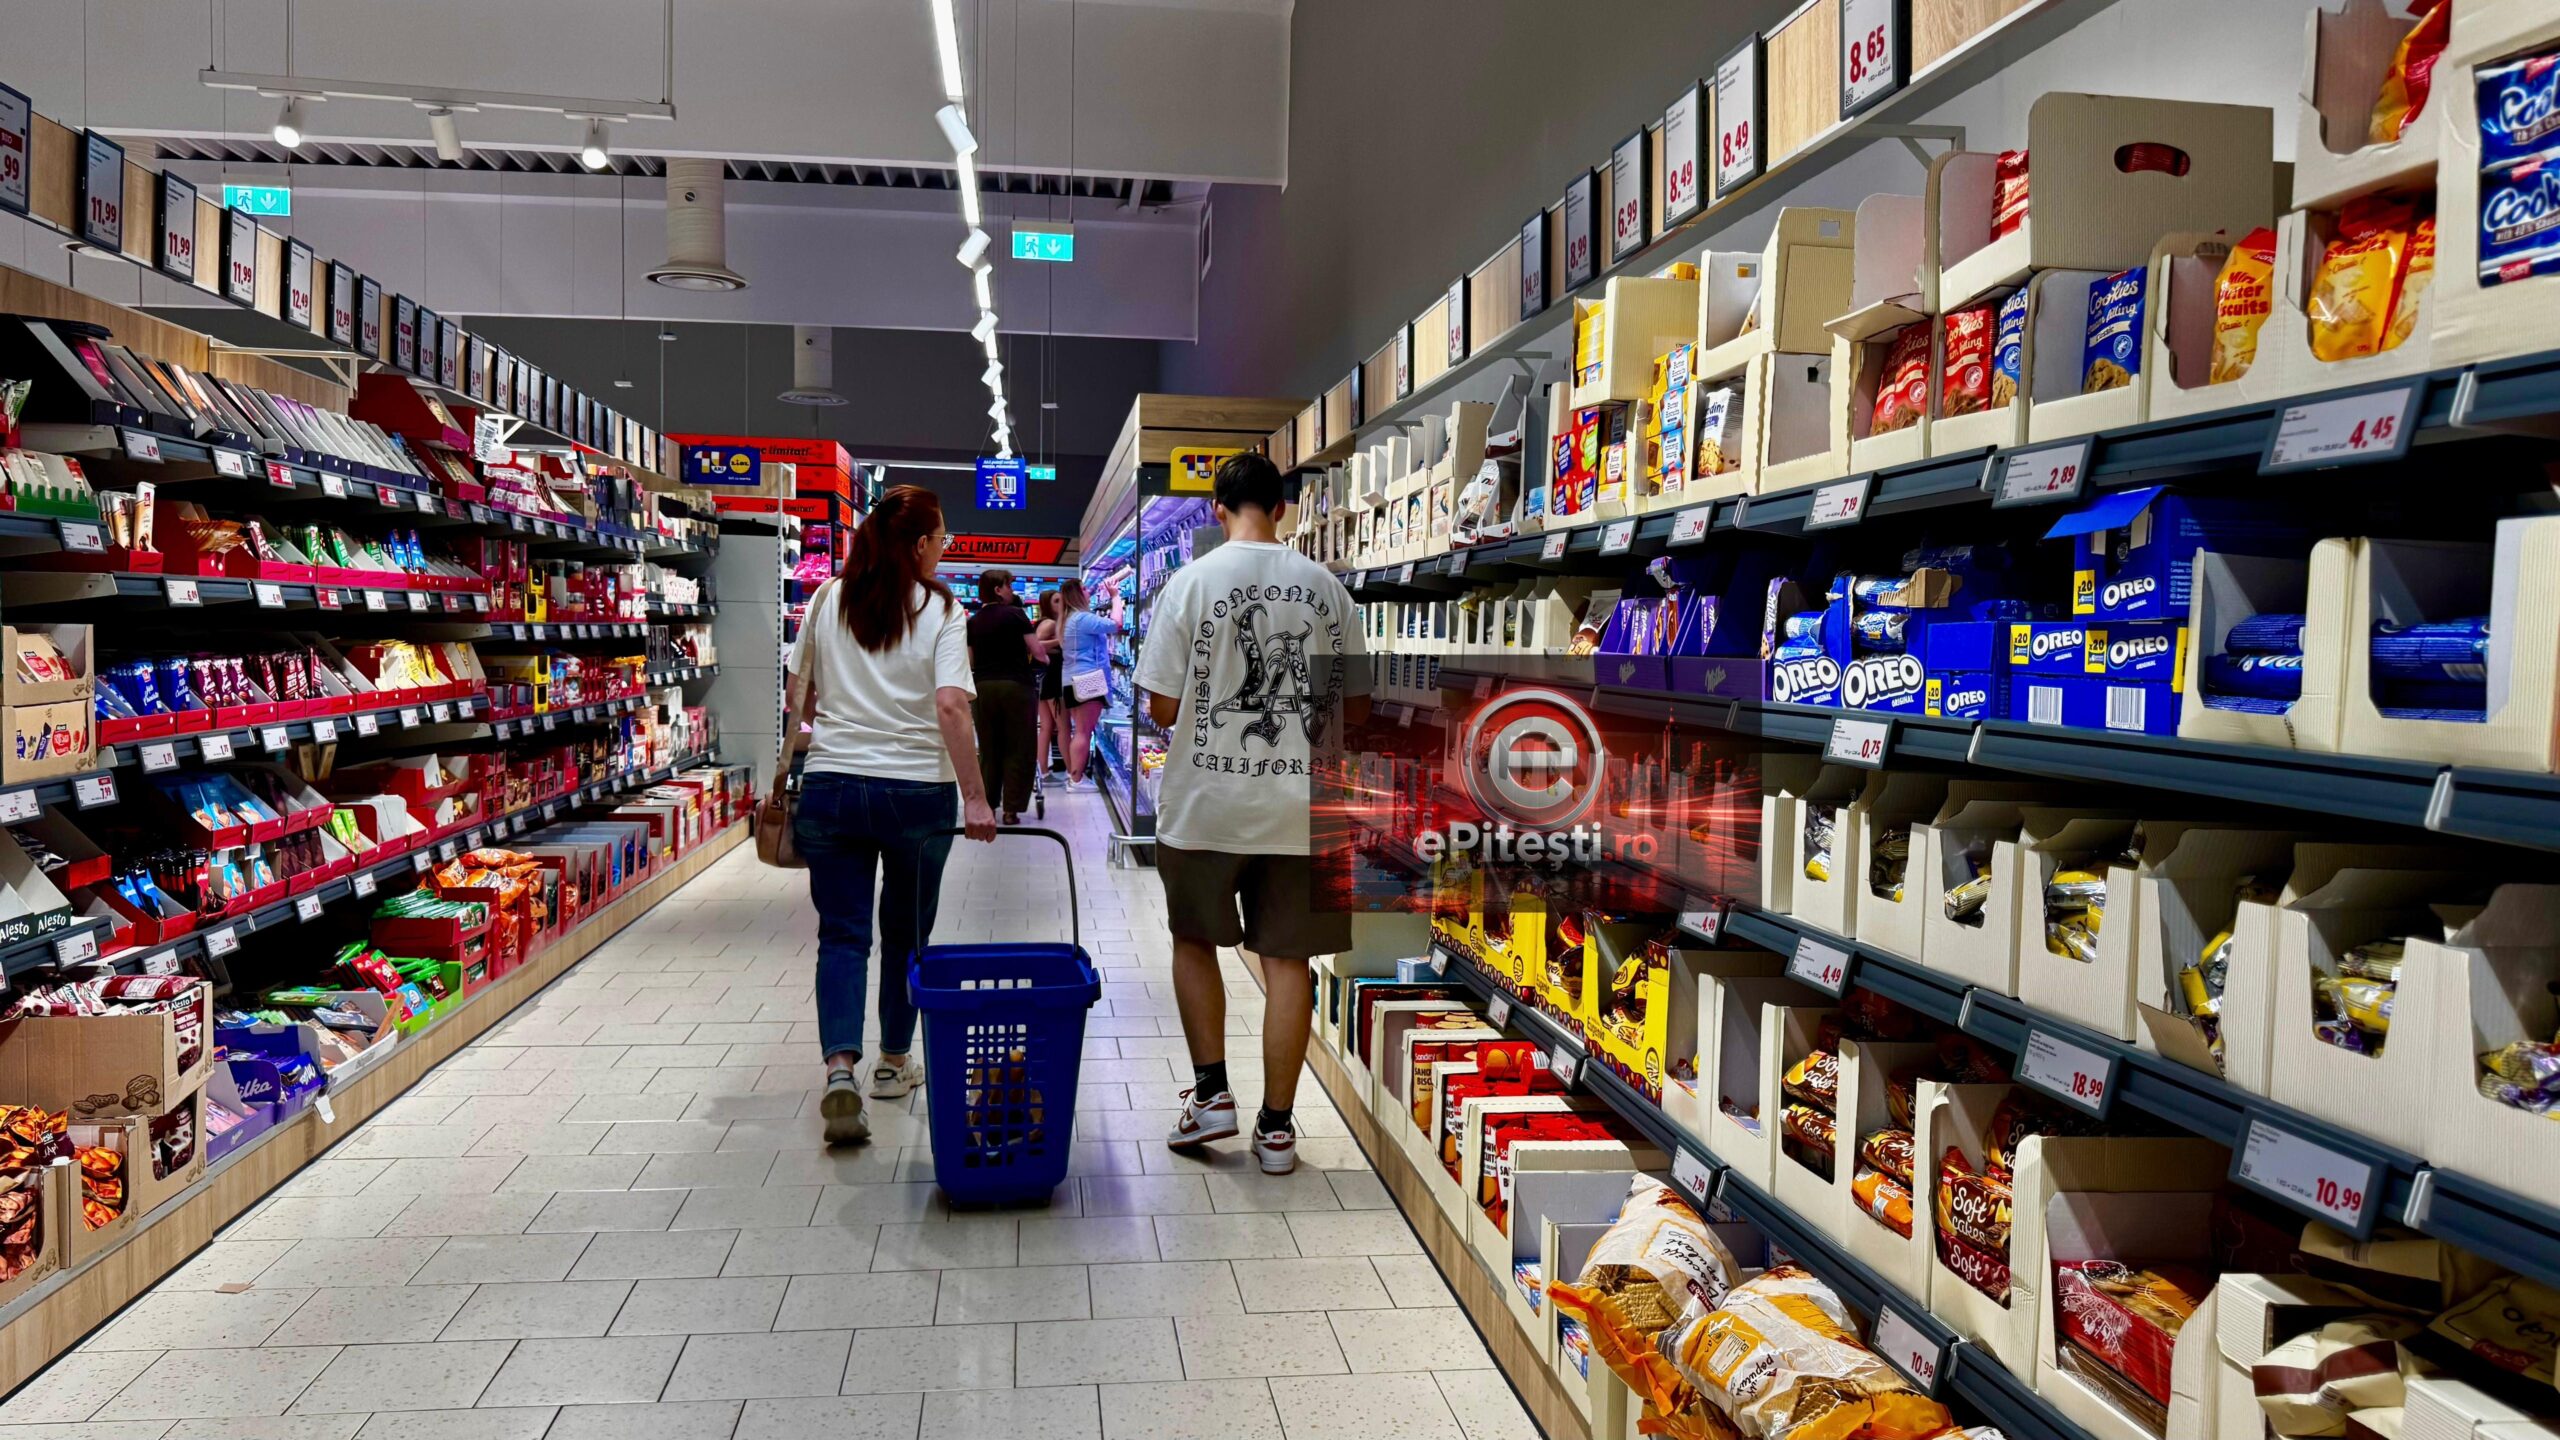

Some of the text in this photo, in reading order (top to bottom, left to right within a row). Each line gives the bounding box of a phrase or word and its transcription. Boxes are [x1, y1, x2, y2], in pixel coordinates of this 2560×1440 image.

[1850, 24, 1885, 84] 8.65
[1723, 120, 1749, 168] 8.49
[1670, 160, 1693, 203] 8.49
[91, 196, 117, 225] 11.99
[1617, 199, 1638, 238] 6.99
[168, 231, 191, 258] 11.99
[1569, 234, 1587, 270] 8.99
[233, 261, 252, 285] 11.99
[292, 289, 309, 309] 12.49
[2000, 293, 2027, 319] ookies
[2090, 280, 2139, 315] Cookies
[2349, 415, 2395, 449] 4.45
[2047, 464, 2076, 491] 2.89
[1840, 496, 1858, 518] 7.19
[969, 541, 1031, 560] LIMITAT!
[2078, 580, 2093, 592] x20
[2102, 577, 2156, 607] OREO
[1213, 584, 1261, 618] ONE
[1194, 620, 1215, 661] NO
[2014, 633, 2028, 644] x20
[2032, 629, 2083, 656] OREO
[2089, 639, 2104, 651] x20
[2109, 635, 2169, 665] OREO
[1774, 656, 1841, 704] OREO
[1841, 654, 1925, 710] OREO
[1928, 687, 1940, 698] x20
[1194, 664, 1210, 748] TRUST
[1813, 692, 1833, 705] ORIGINAL
[1891, 695, 1915, 707] ORIGINAL
[1946, 690, 1987, 715] OREO
[1861, 738, 1882, 759] 0.75
[0, 921, 30, 943] Alesto
[37, 913, 67, 934] Alesto
[1702, 915, 1716, 932] 4.49
[1822, 963, 1842, 994] 4.49
[170, 998, 191, 1011] Alesto
[1586, 1015, 1606, 1042] Eugenia
[1815, 1056, 1838, 1078] Sof
[236, 1079, 272, 1103] ilka
[2072, 1071, 2103, 1098] 18.99
[1692, 1175, 1706, 1193] 7.99
[2316, 1177, 2362, 1211] 10.99
[1952, 1185, 1987, 1224] Soft
[1952, 1215, 1987, 1245] cakes
[1950, 1245, 1984, 1282] Soft
[1911, 1351, 1935, 1379] 10.99
